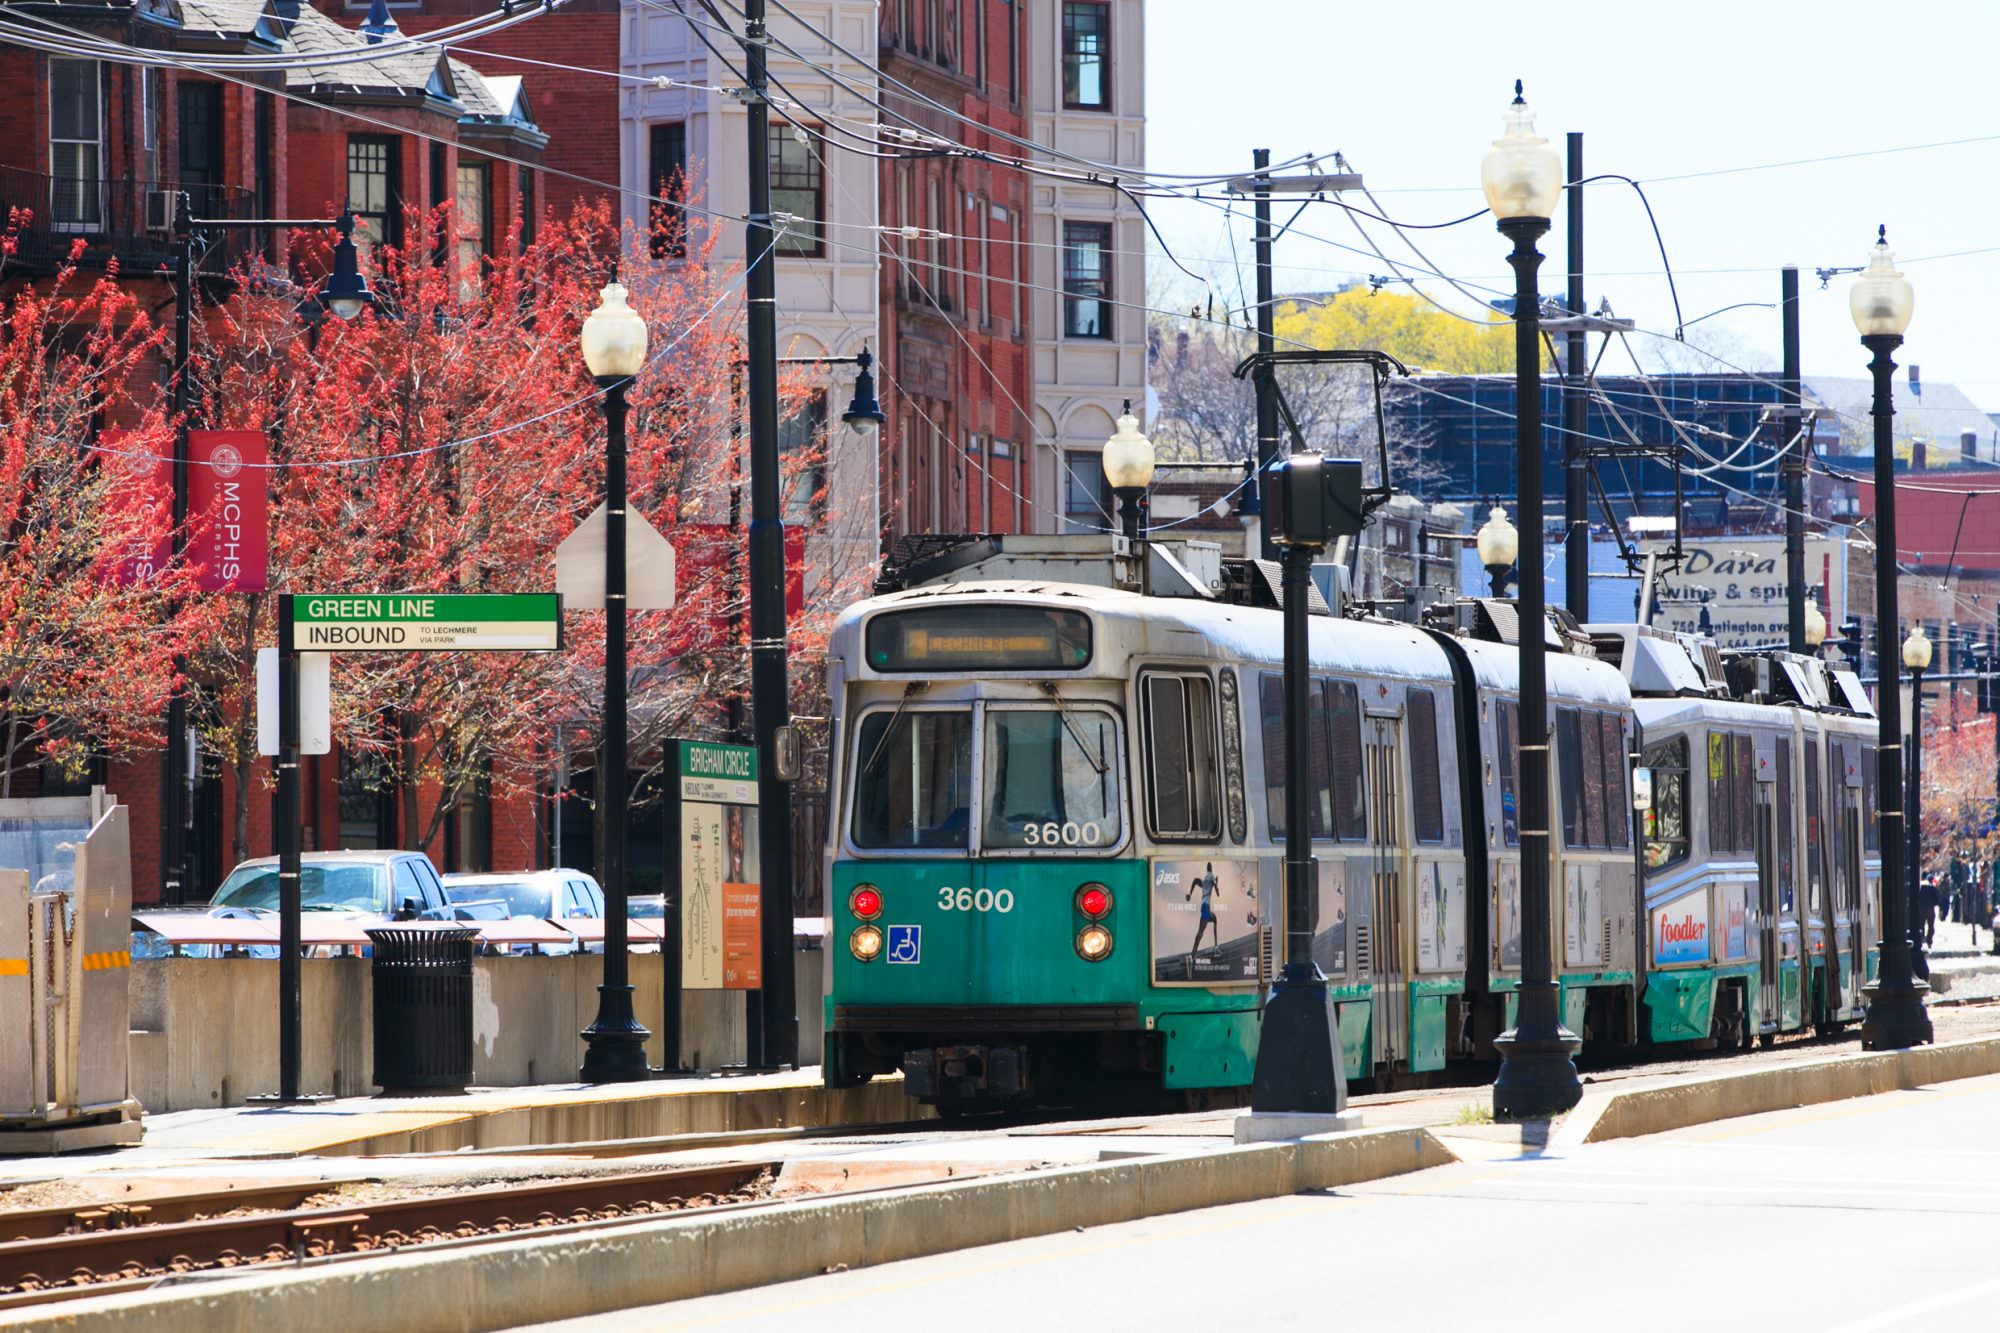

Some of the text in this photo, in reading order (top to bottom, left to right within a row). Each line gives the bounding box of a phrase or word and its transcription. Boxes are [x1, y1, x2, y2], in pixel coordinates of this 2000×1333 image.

[223, 482, 240, 580] MCPHS
[1682, 548, 1776, 574] Dara
[1725, 583, 1741, 599] &
[308, 599, 435, 618] GREEN LINE
[309, 626, 406, 644] INBOUND
[420, 626, 478, 634] TO LECHMERE
[690, 747, 749, 776] BRIGHAM CIRCLE
[1023, 822, 1100, 846] 3600
[937, 886, 1015, 914] 3600
[1659, 914, 1705, 954] foodler
